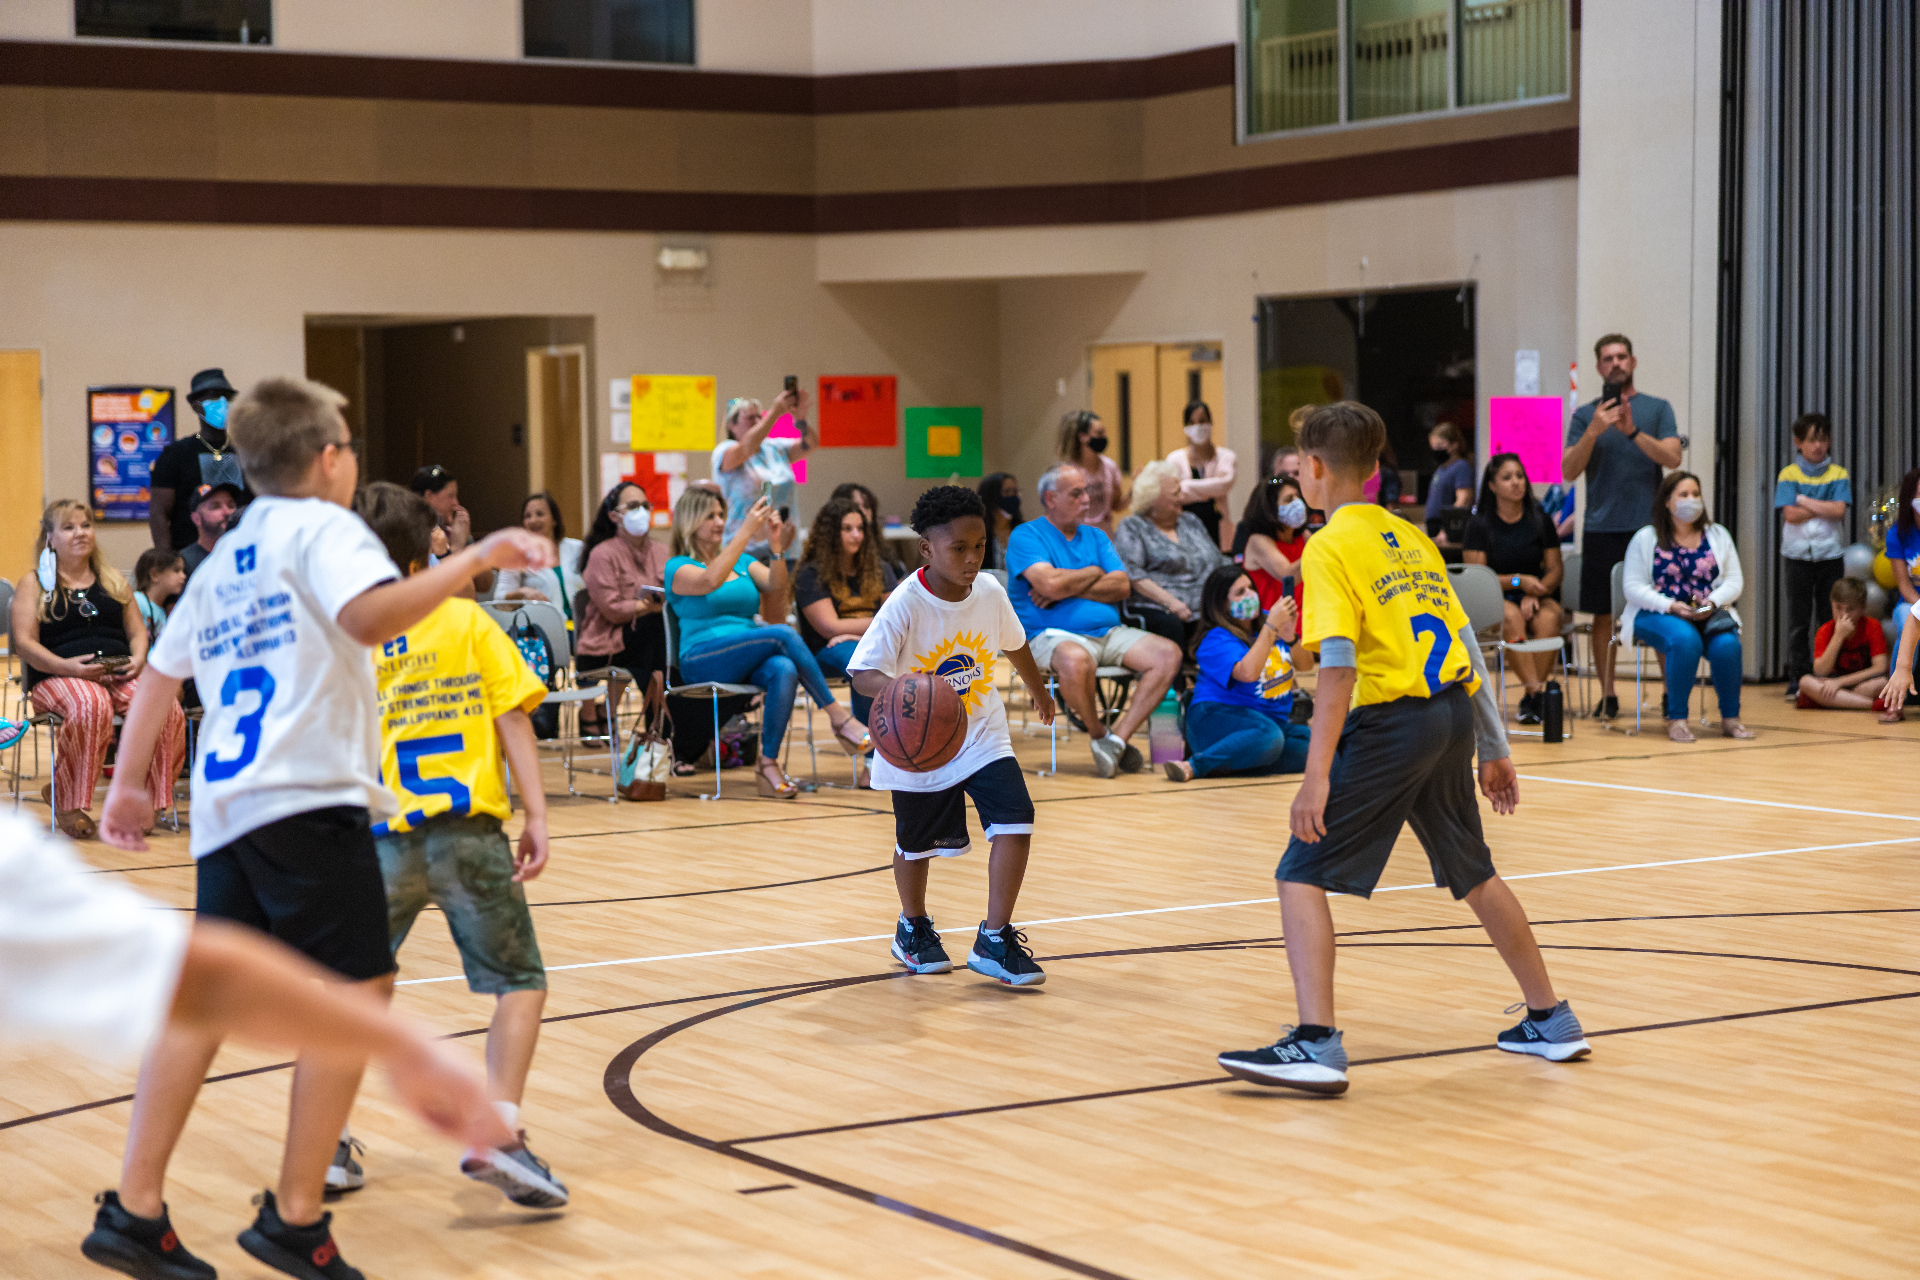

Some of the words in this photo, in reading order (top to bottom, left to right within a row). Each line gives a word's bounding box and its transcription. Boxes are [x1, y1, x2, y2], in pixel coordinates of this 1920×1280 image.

[377, 651, 437, 677] NLIGHT
[1409, 612, 1474, 696] 2
[392, 680, 429, 697] THINGS
[388, 691, 464, 714] STRENGTHENS
[204, 666, 276, 783] 3
